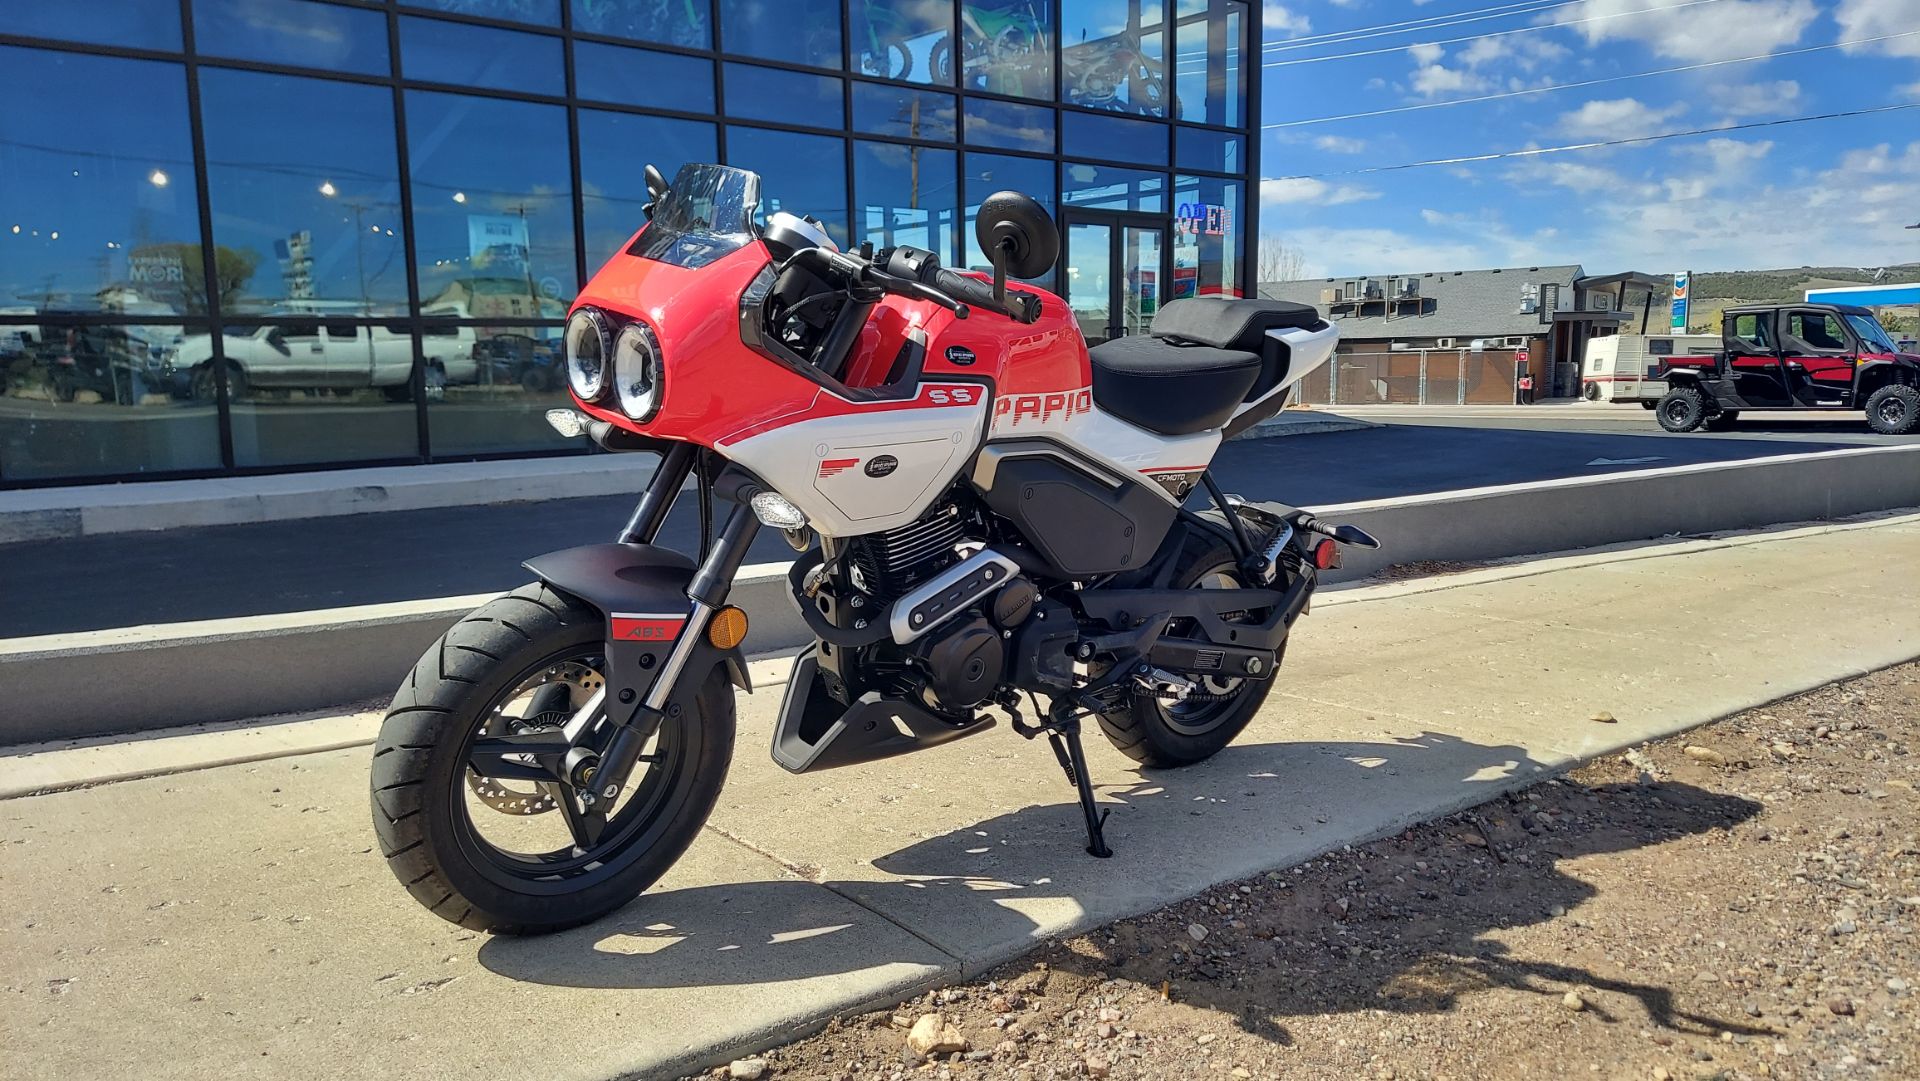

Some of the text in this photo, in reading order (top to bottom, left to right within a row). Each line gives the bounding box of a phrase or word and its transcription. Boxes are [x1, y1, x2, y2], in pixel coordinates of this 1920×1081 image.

[1178, 203, 1232, 236] OPEN
[928, 388, 972, 404] SS
[991, 390, 1092, 431] PAPIO
[1157, 473, 1186, 481] CFMOTO
